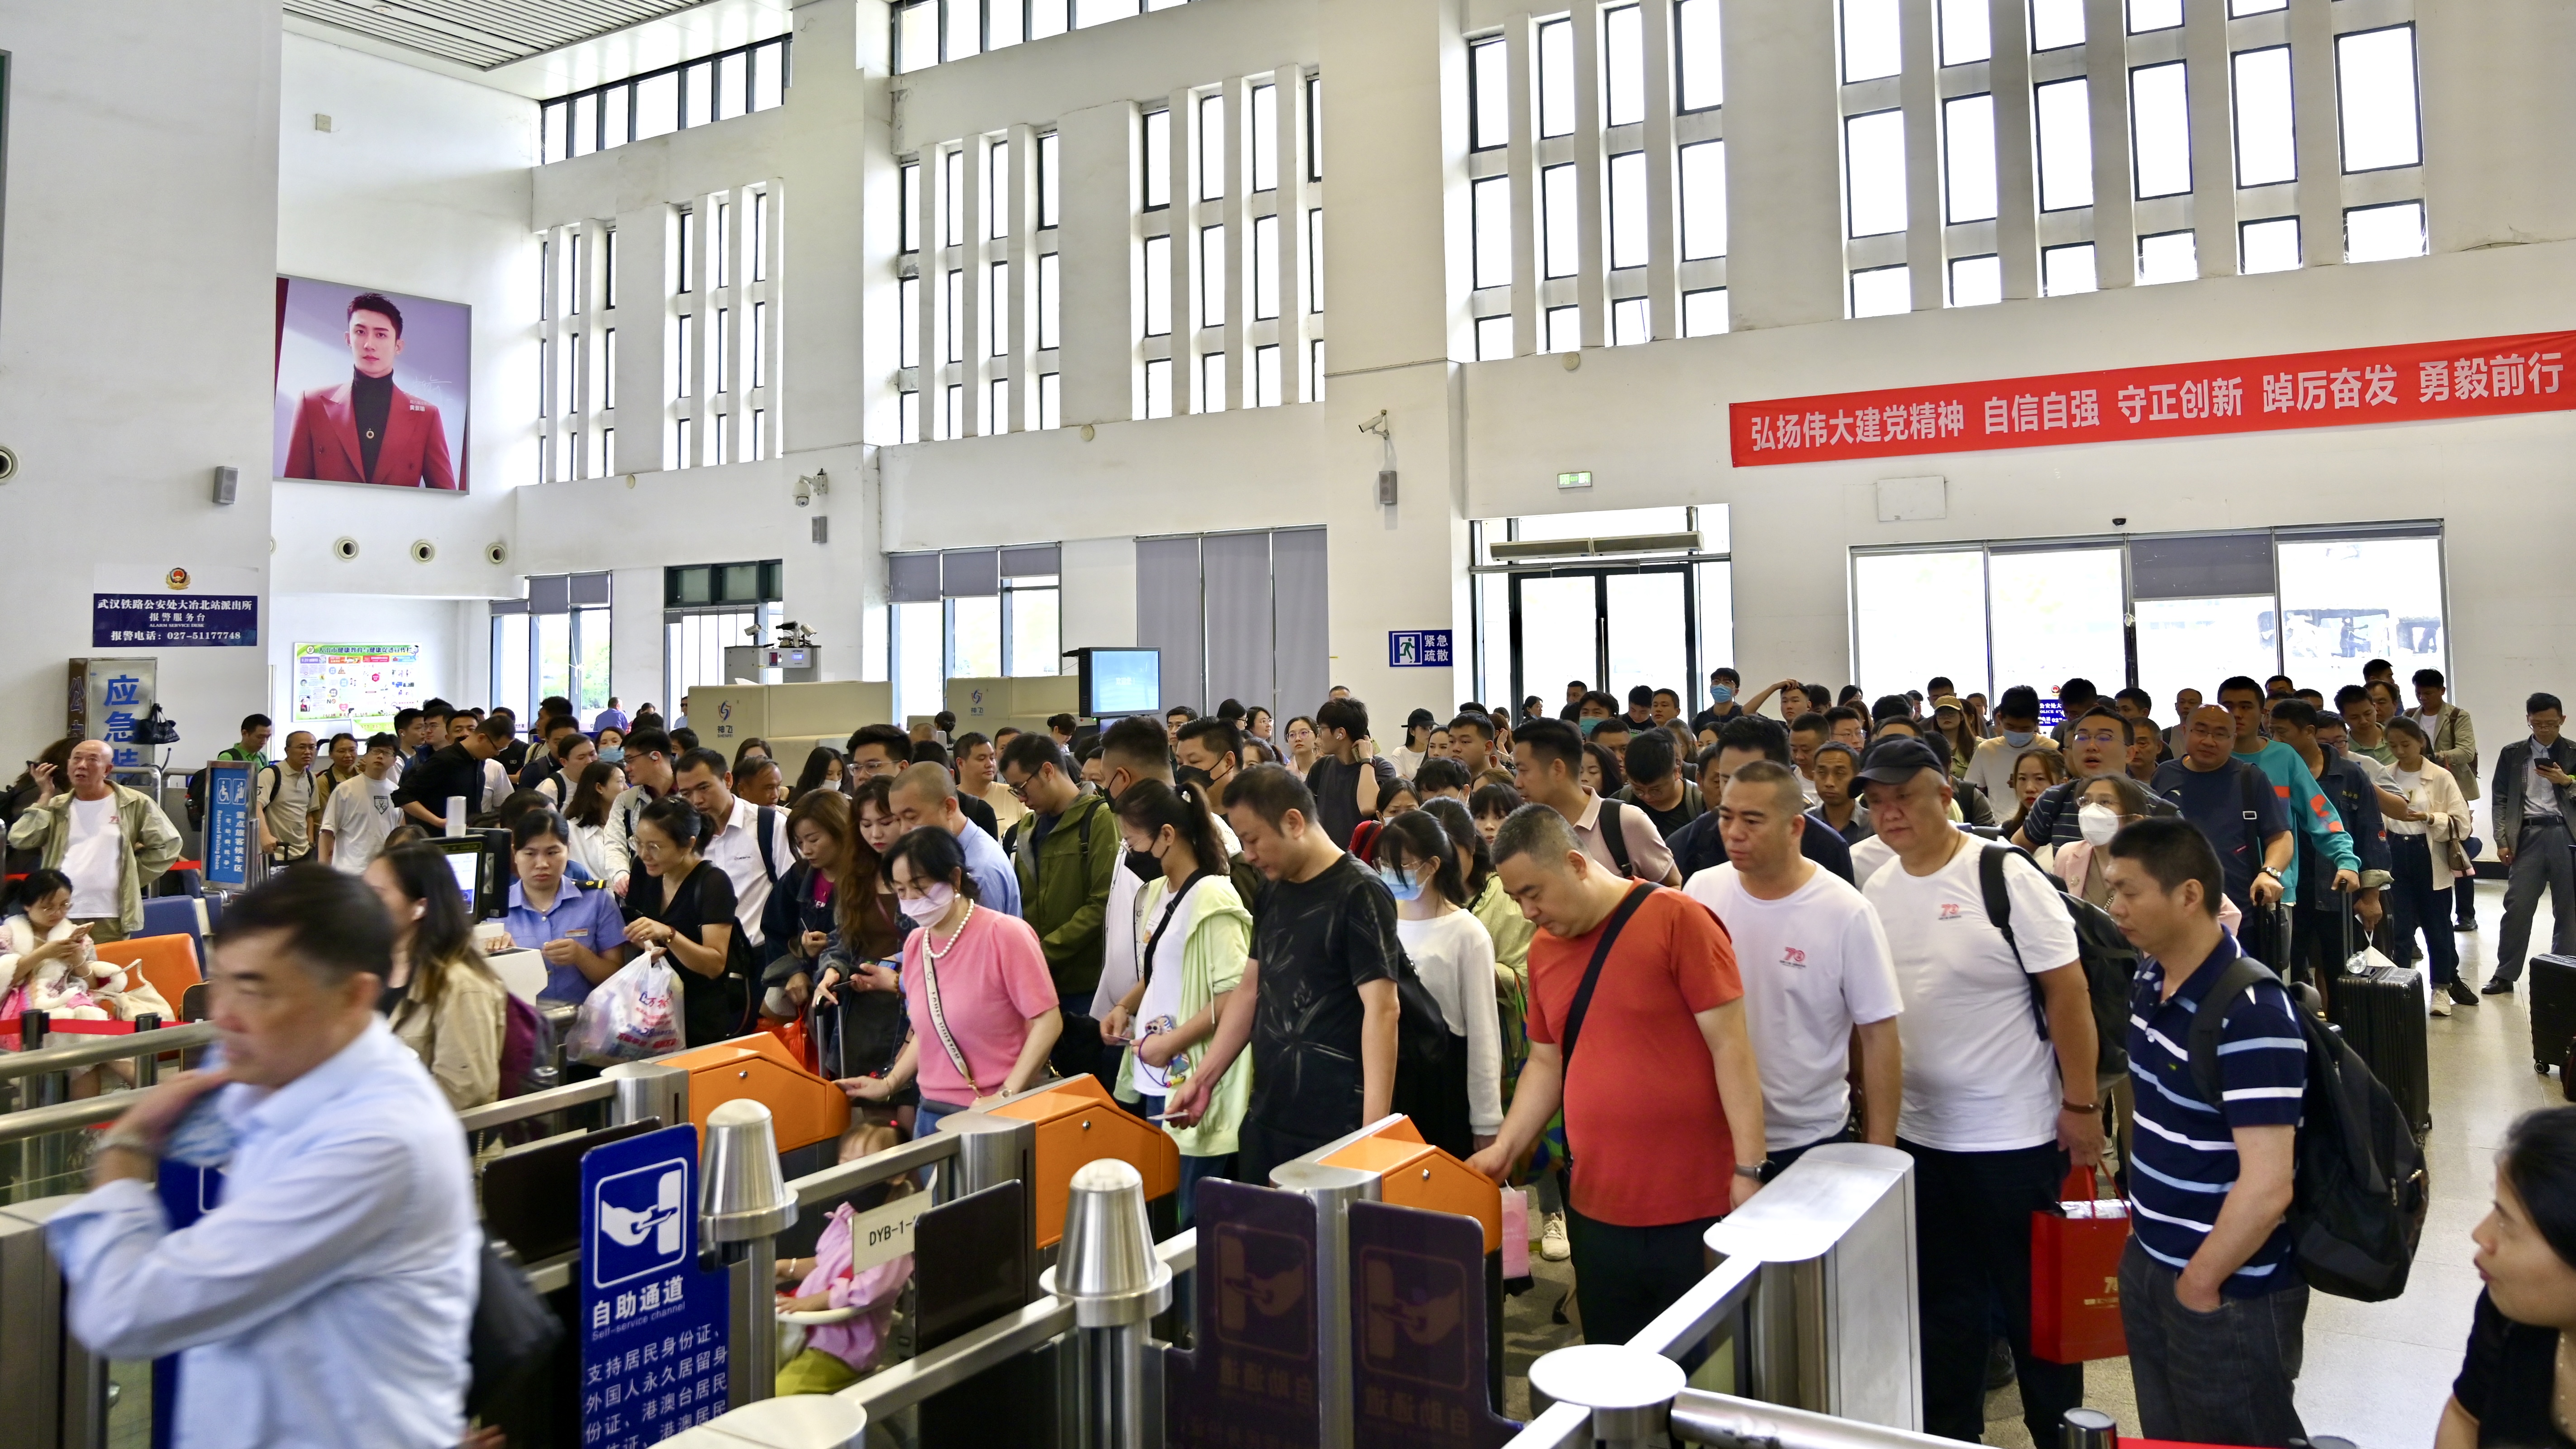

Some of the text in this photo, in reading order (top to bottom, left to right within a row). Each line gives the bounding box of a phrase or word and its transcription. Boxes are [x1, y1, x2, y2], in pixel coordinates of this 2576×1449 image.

[1751, 352, 2564, 451] 弘扬伟大建党精神 自信自强 守正创新 踔厉奋发 勇毅前行
[97, 599, 252, 611] 武汉铁路公安处大冶北站派出所
[149, 612, 205, 622] 报警服务台
[1424, 634, 1448, 647] 紧急
[1424, 649, 1448, 662] 疏散
[234, 811, 245, 872] 重点旅客候车区
[1785, 947, 1805, 962] 70
[870, 1215, 916, 1246] DYB-1-
[593, 1275, 684, 1329] 自助通道
[592, 1301, 686, 1341] Self-service channel
[586, 1346, 728, 1414] 外国人永久居留身
